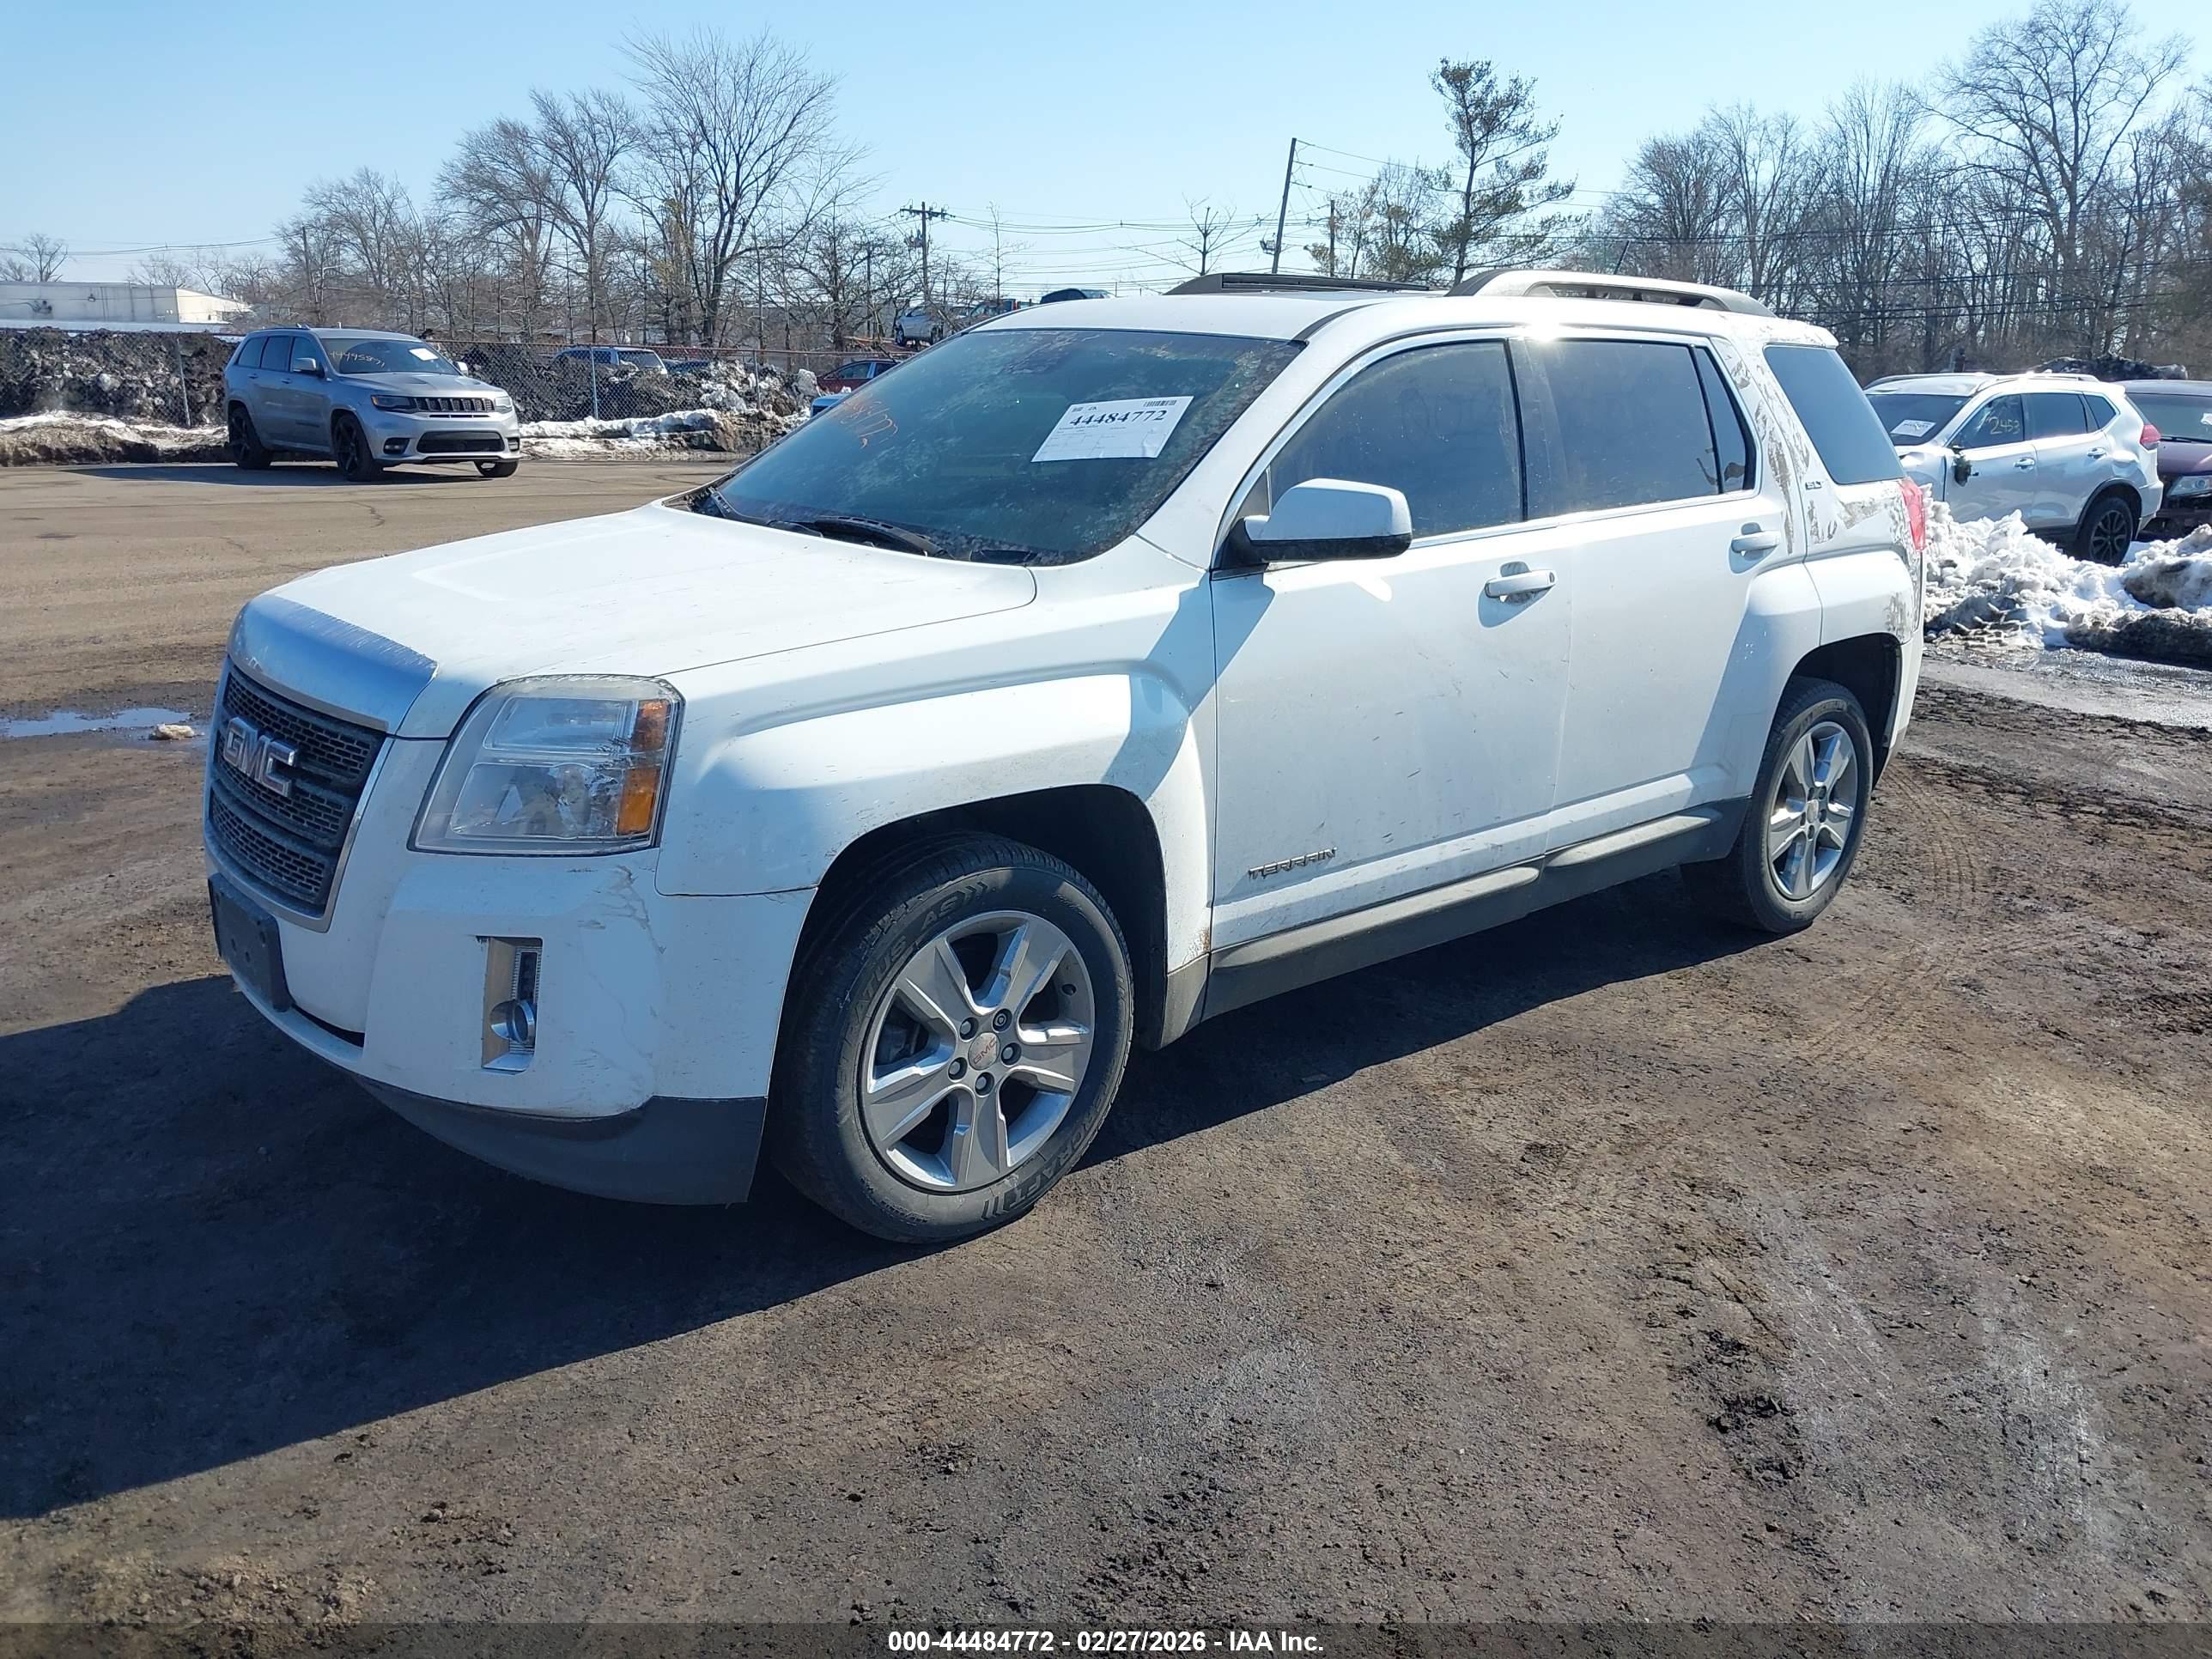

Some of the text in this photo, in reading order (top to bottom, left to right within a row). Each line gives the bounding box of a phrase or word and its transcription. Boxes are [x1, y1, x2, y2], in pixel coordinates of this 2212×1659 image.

[1070, 410, 1168, 427] 44484772
[1805, 481, 1822, 490] SLT
[223, 716, 296, 798] GMC
[1248, 847, 1338, 879] TERRAIN
[973, 1036, 997, 1065] GMC
